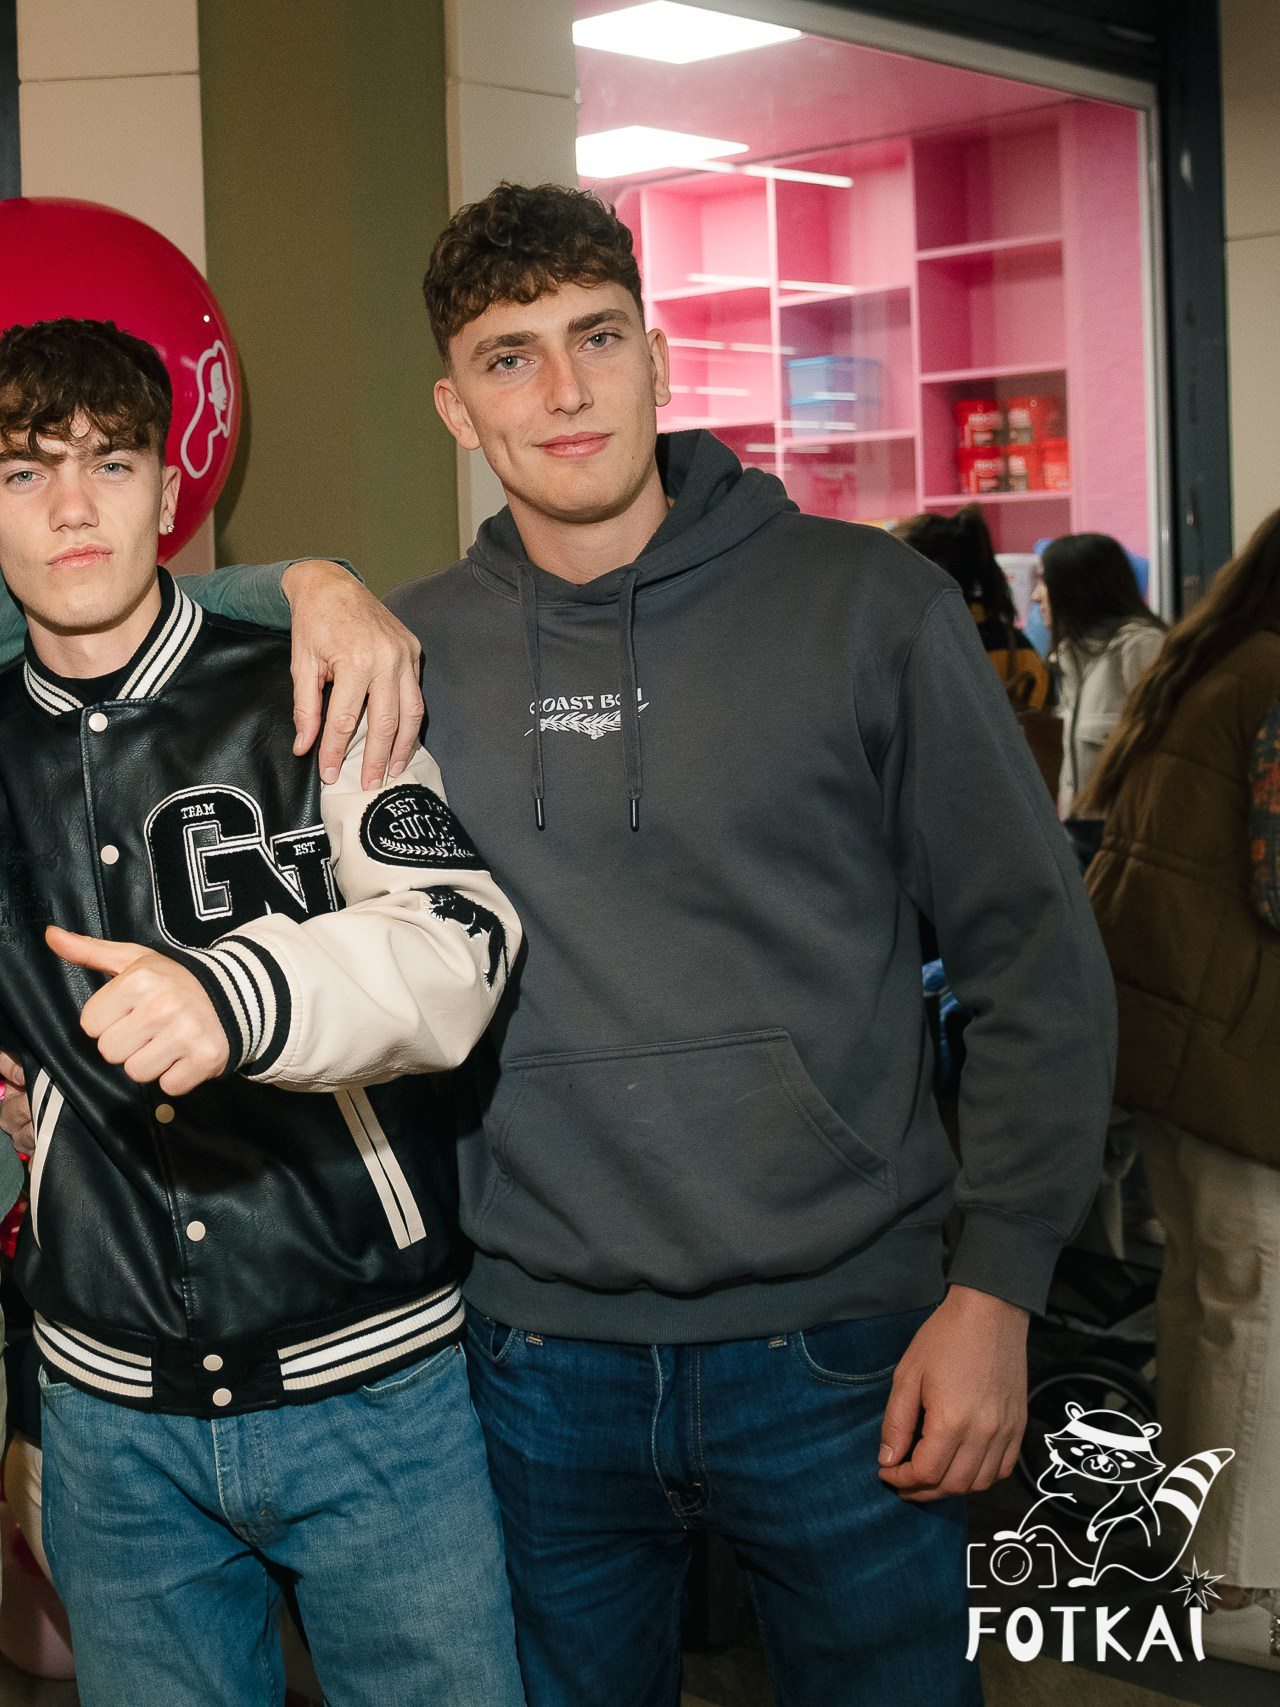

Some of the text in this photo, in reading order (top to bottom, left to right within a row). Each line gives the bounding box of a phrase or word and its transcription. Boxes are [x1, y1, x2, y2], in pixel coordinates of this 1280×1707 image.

[180, 803, 216, 819] TEAM
[384, 797, 419, 818] EST
[292, 841, 322, 857] EST.
